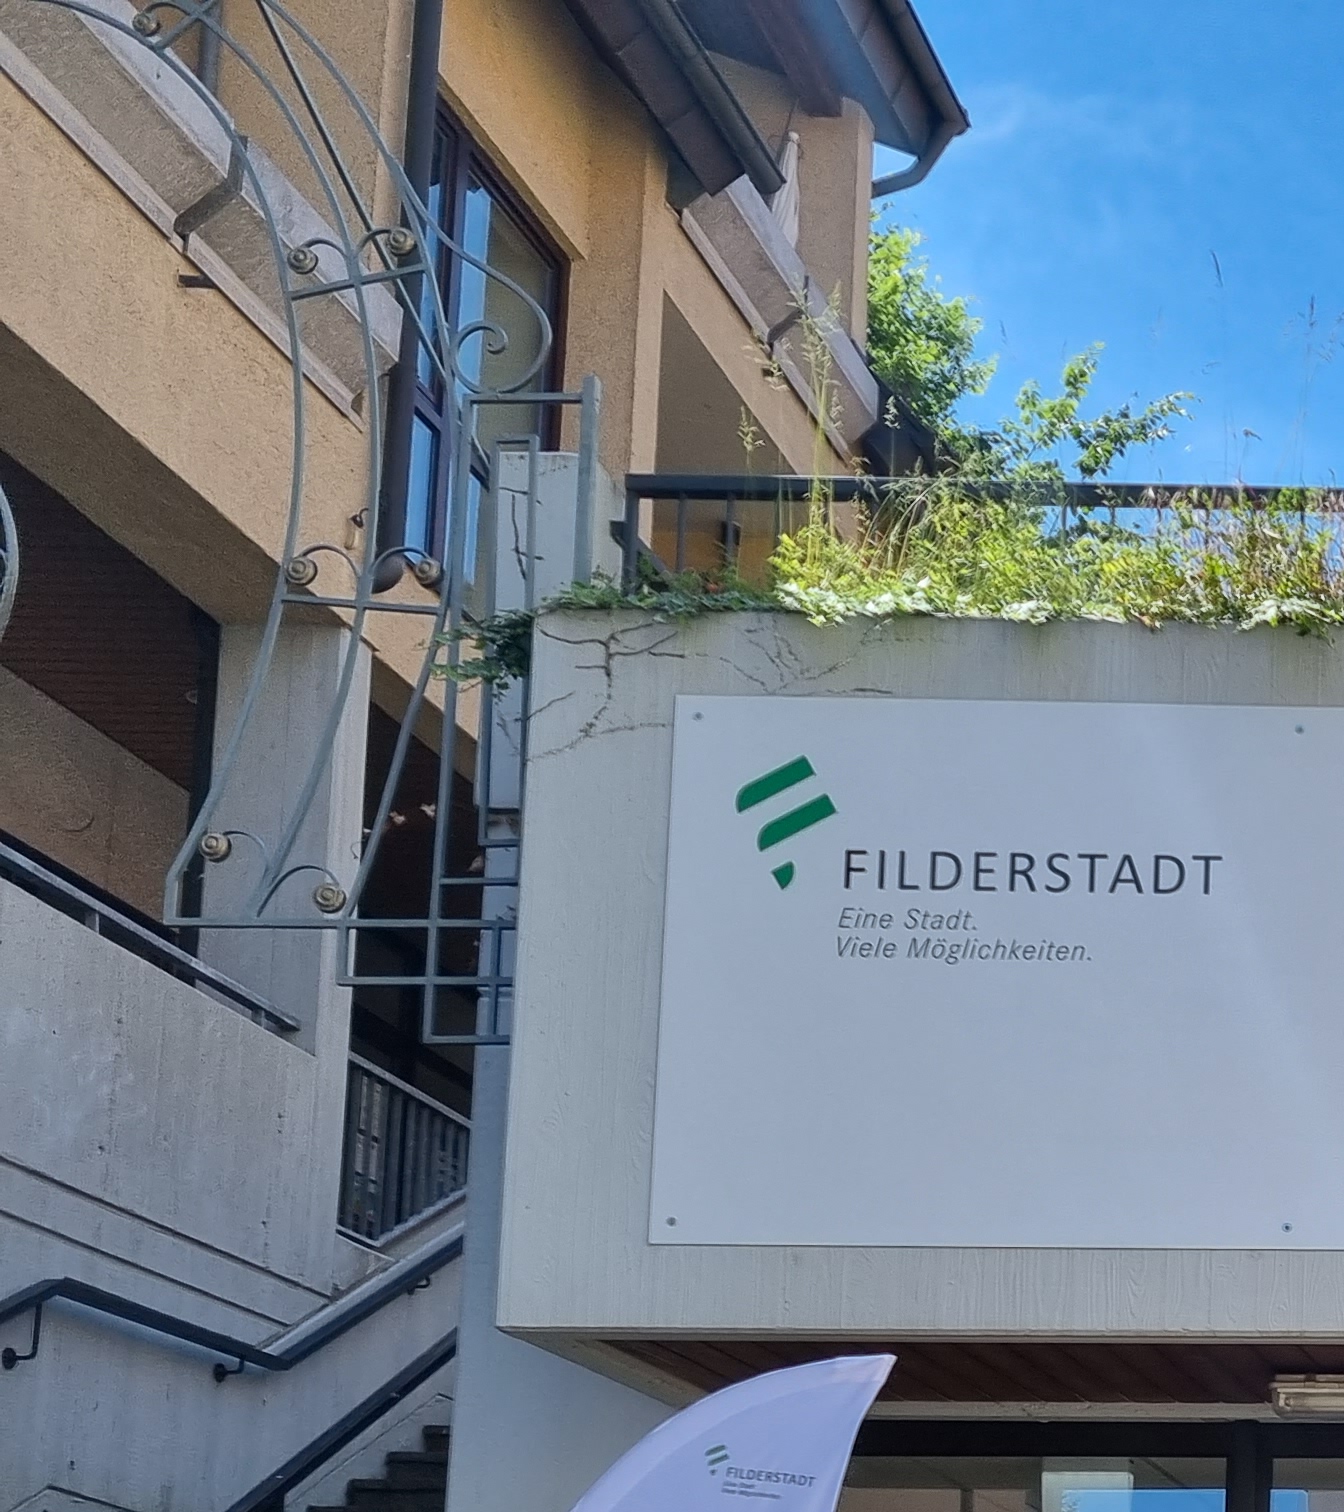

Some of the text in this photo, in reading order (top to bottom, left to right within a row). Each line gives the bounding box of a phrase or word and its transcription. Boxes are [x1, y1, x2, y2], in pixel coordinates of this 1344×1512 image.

[843, 849, 1223, 896] FILDERSTADT
[838, 907, 978, 931] Eine Stadt.
[836, 936, 1093, 966] Viele Möglichkeiten.
[725, 1466, 817, 1488] FILDERSTADT
